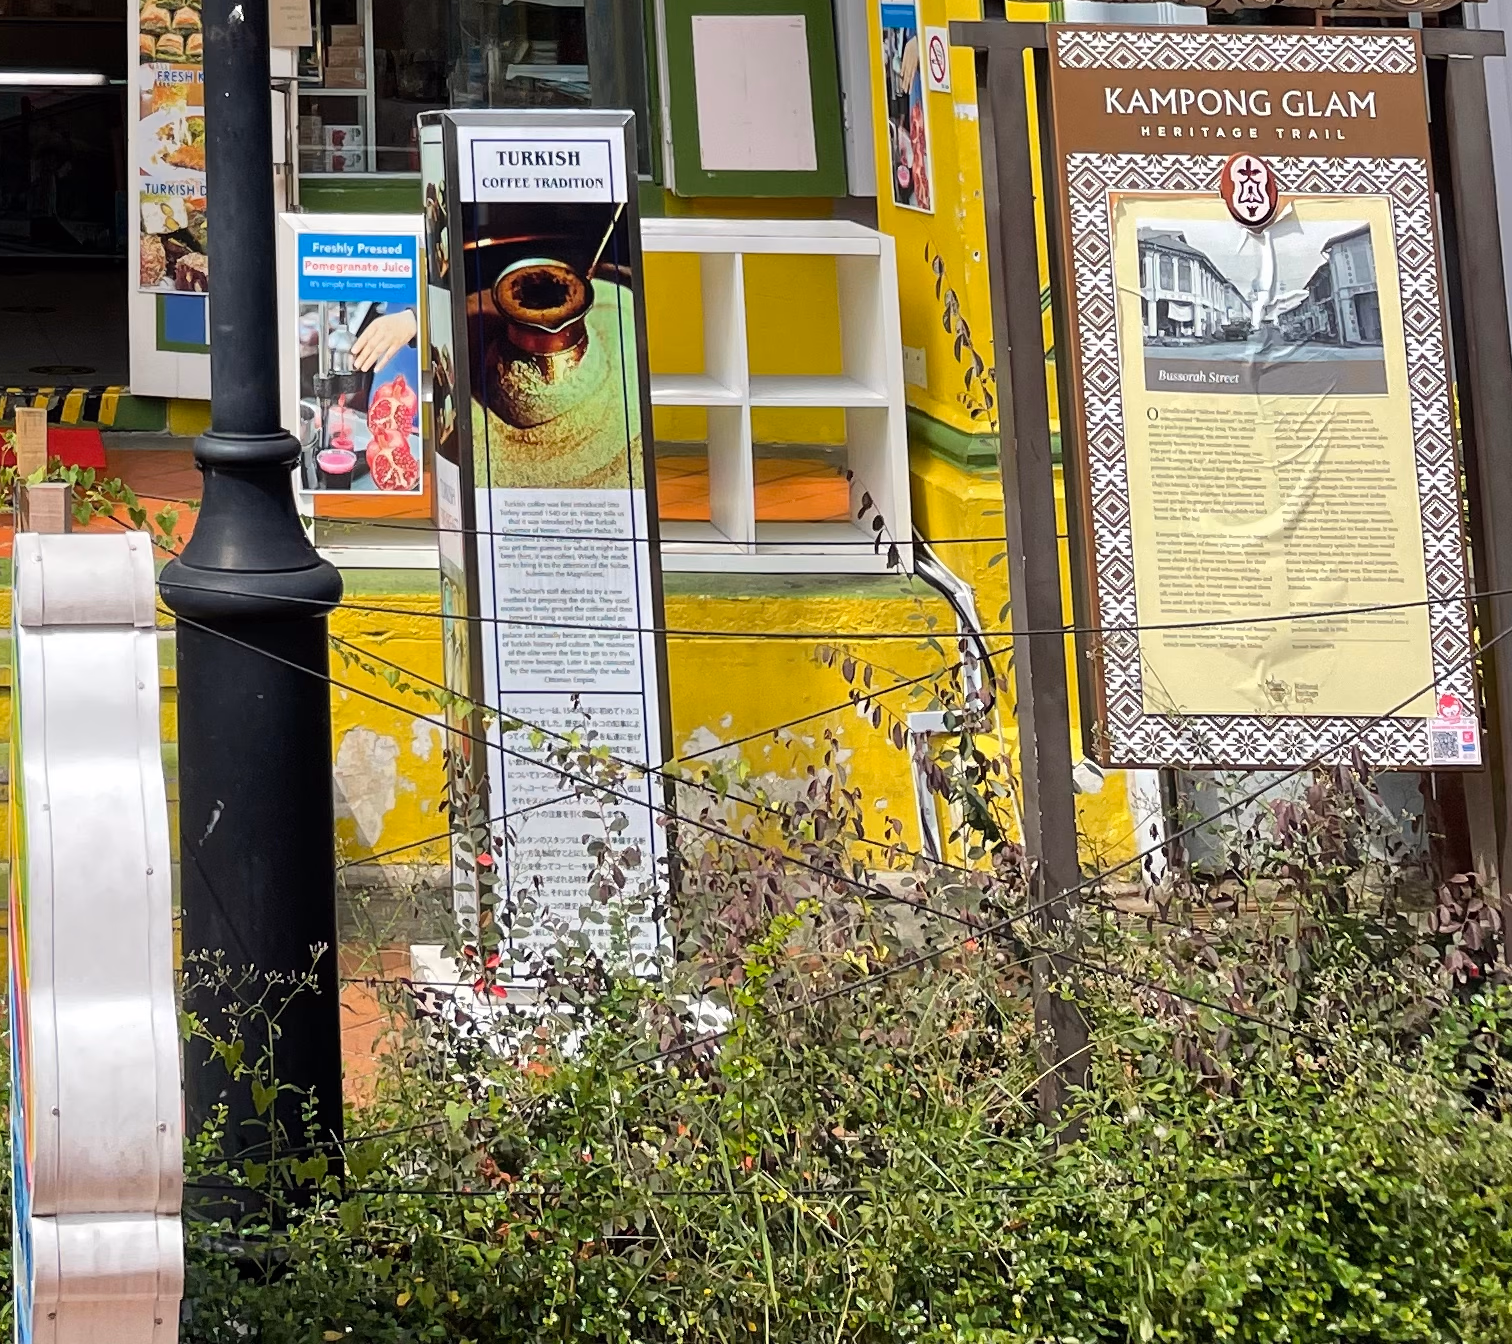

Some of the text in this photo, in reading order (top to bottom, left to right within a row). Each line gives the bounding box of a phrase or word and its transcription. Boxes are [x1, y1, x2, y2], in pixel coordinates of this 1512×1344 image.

[157, 70, 193, 83] FRESH
[1104, 86, 1377, 118] KAMPONG GLAM
[1141, 125, 1347, 141] HERITAGE TRAIL
[496, 150, 581, 166] TURKISH
[144, 182, 196, 197] TURKISH
[482, 177, 605, 189] COFFEE TRADITION
[312, 241, 403, 256] Freshly Pressed
[304, 260, 411, 274] Pomegranate Juice
[1158, 369, 1240, 384] Bussorah Street
